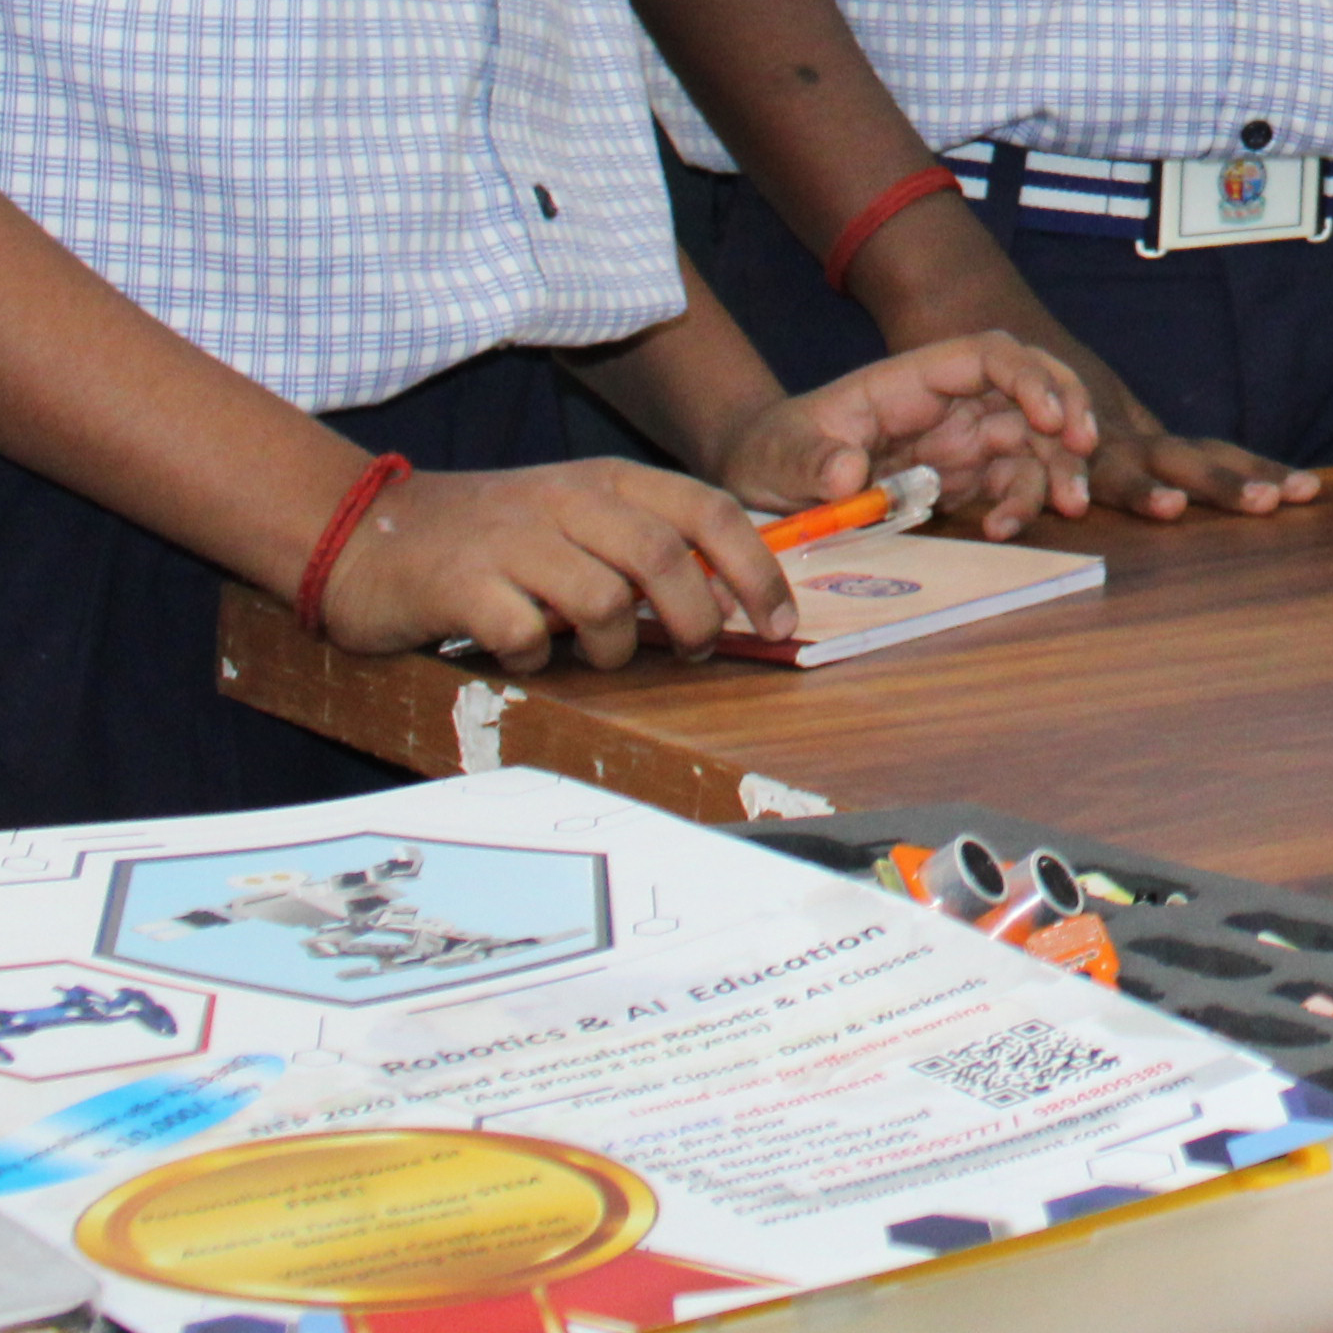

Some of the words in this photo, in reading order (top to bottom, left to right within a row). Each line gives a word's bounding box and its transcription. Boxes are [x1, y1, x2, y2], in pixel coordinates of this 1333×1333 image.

[322, 1094, 395, 1124] 2020
[404, 1072, 493, 1106] based
[499, 1035, 656, 1083] Curriculum
[662, 1004, 768, 1044] Robotic
[774, 996, 796, 1010] &
[805, 980, 832, 1000] AI
[839, 941, 935, 986] Classes
[379, 1025, 567, 1081] Robotics
[577, 1015, 613, 1035] &
[627, 995, 668, 1022] AI
[687, 921, 886, 1005] Education
[531, 1064, 603, 1091] group
[698, 1019, 771, 1052] years)
[572, 1078, 664, 1111] Flexible
[672, 1055, 759, 1086] Classes
[779, 1029, 839, 1056] Daily
[845, 1020, 866, 1036] &
[870, 974, 987, 1027] Weekends
[629, 1089, 709, 1119] Limited
[776, 1064, 807, 1083] for
[813, 1030, 900, 1070] effective
[904, 999, 991, 1038] learning
[734, 1069, 886, 1123] edutainment
[757, 1118, 838, 1148] Square
